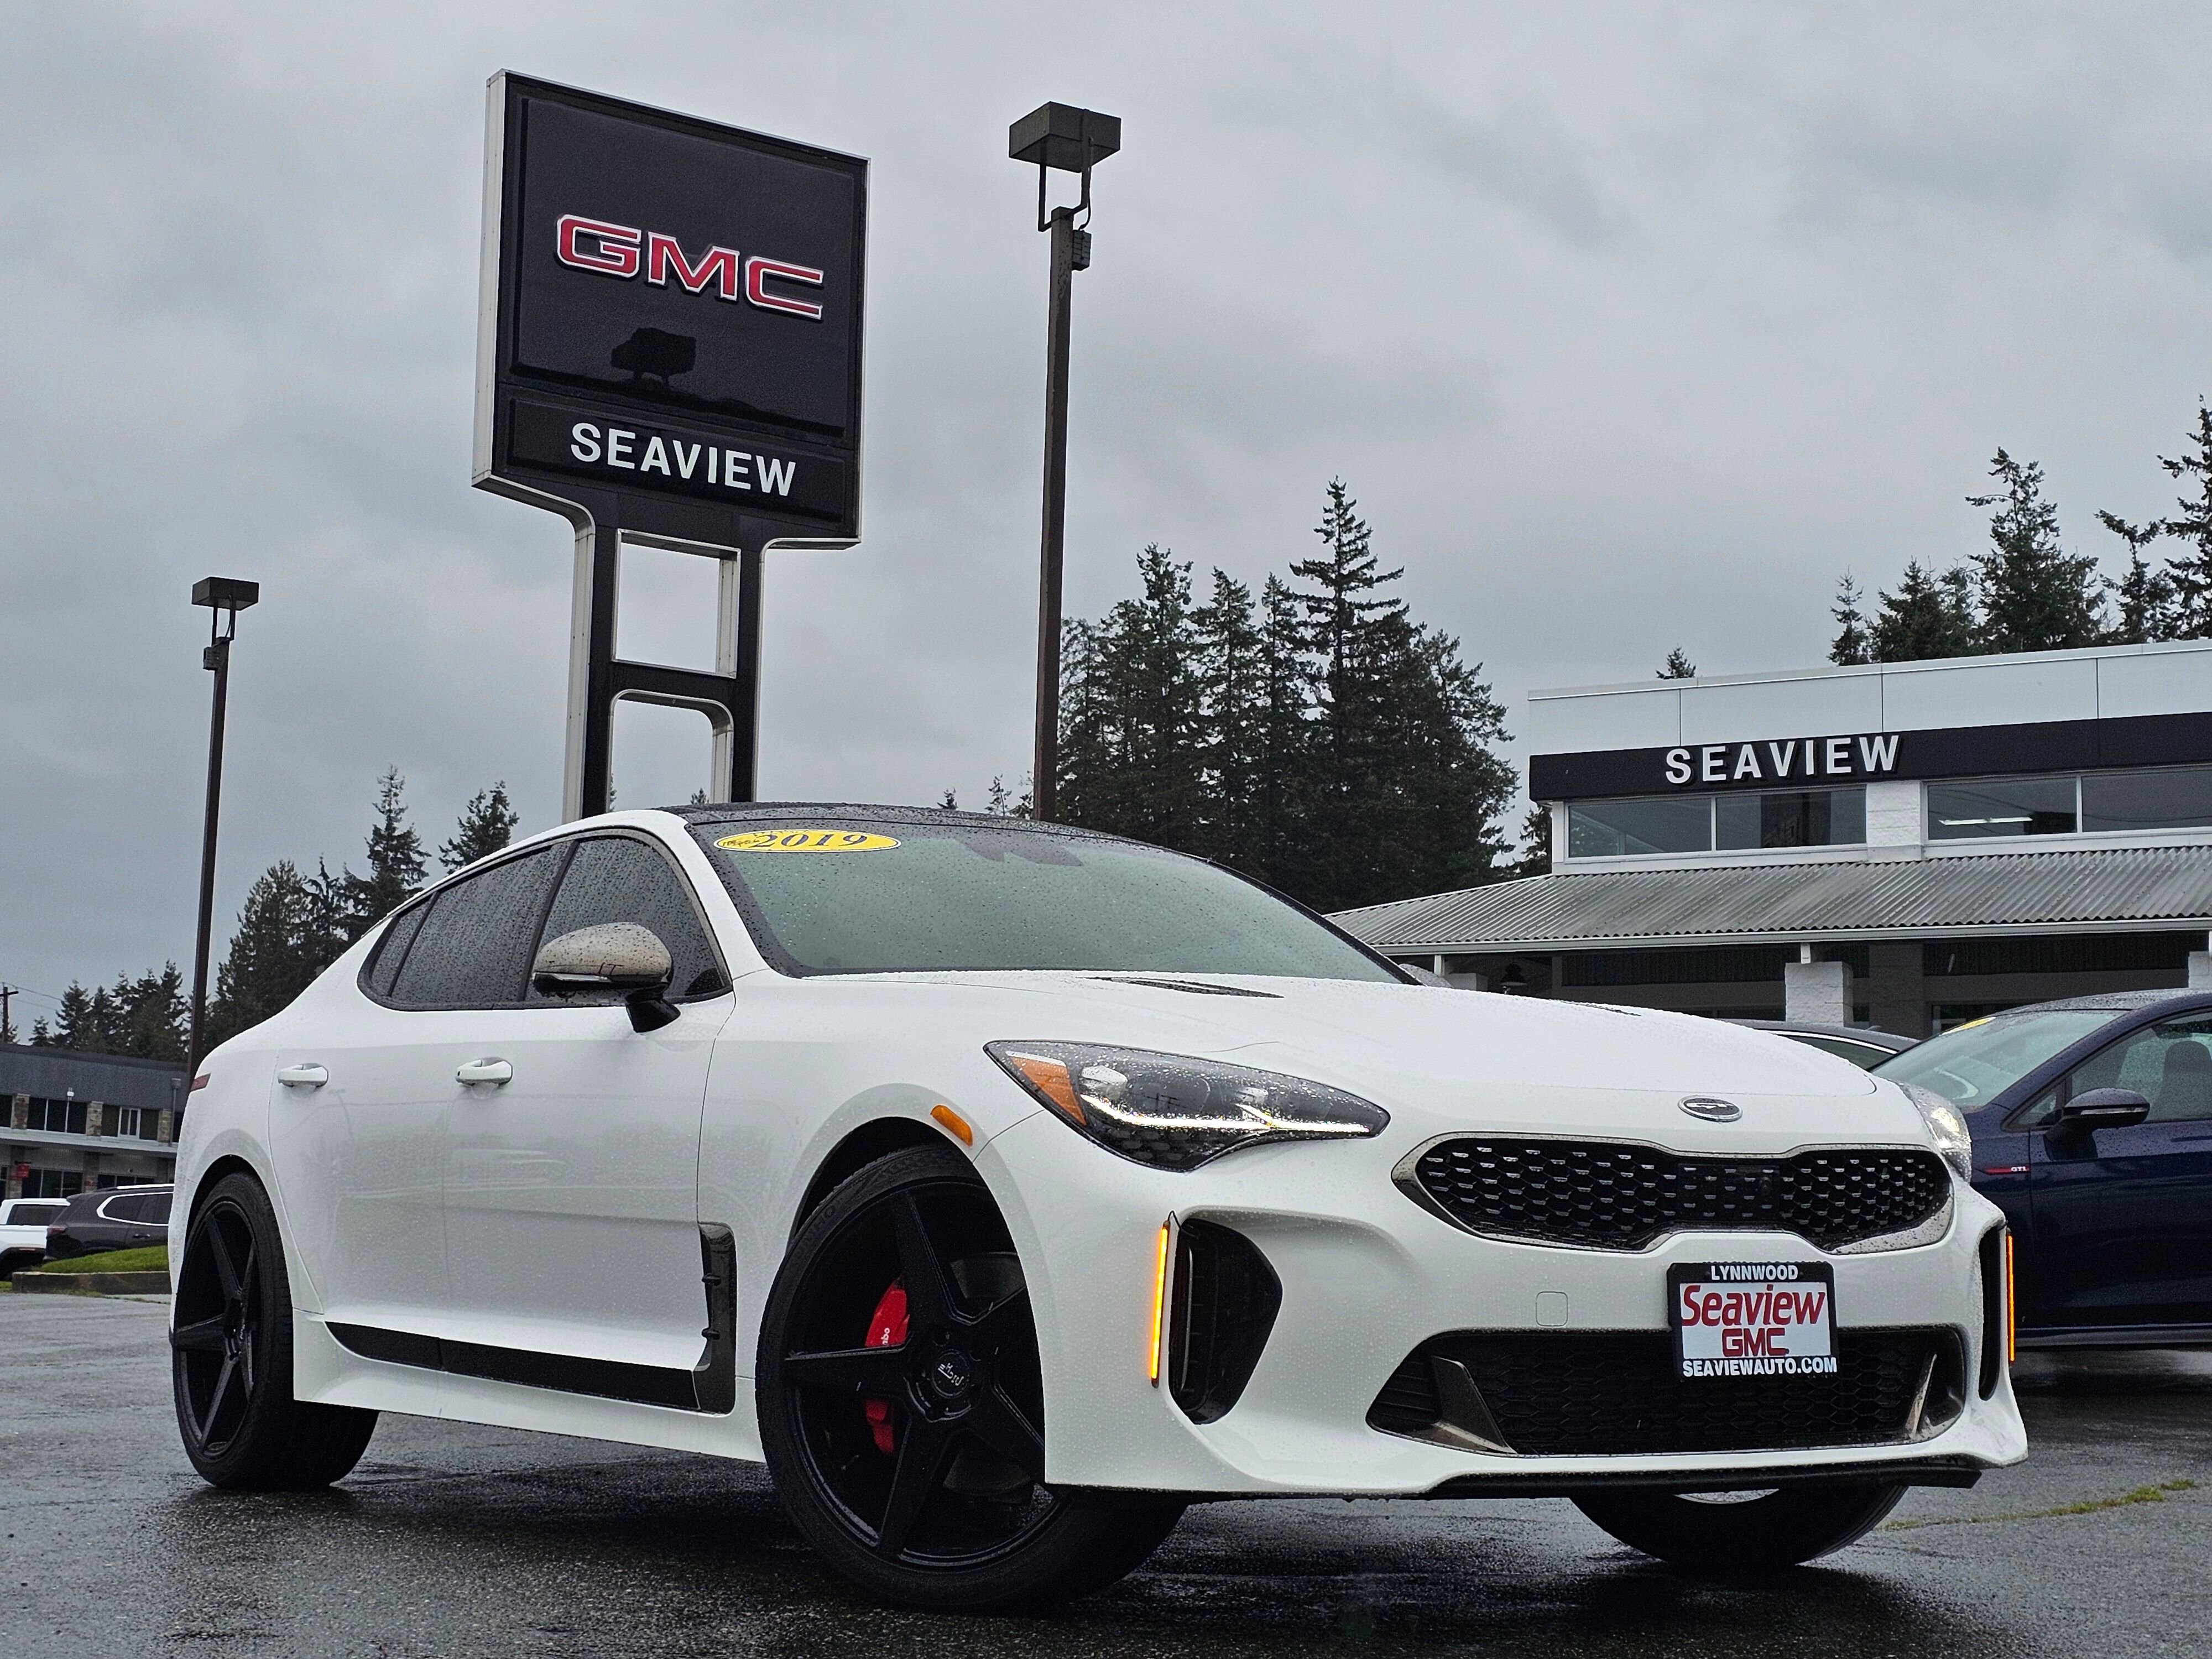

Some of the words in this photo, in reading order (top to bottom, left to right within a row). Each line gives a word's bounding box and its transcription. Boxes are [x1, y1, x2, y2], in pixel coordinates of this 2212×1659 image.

[556, 214, 824, 320] GMC
[570, 422, 796, 496] SEAVIEW
[1665, 735, 1900, 784] SEAVIEW
[748, 833, 868, 848] 2019
[1710, 1265, 1798, 1280] LYNNWOOD
[1681, 1284, 1826, 1326] Seaview
[1721, 1327, 1789, 1357] GMC
[1683, 1357, 1838, 1377] SEAVIEWAUTO.COM
